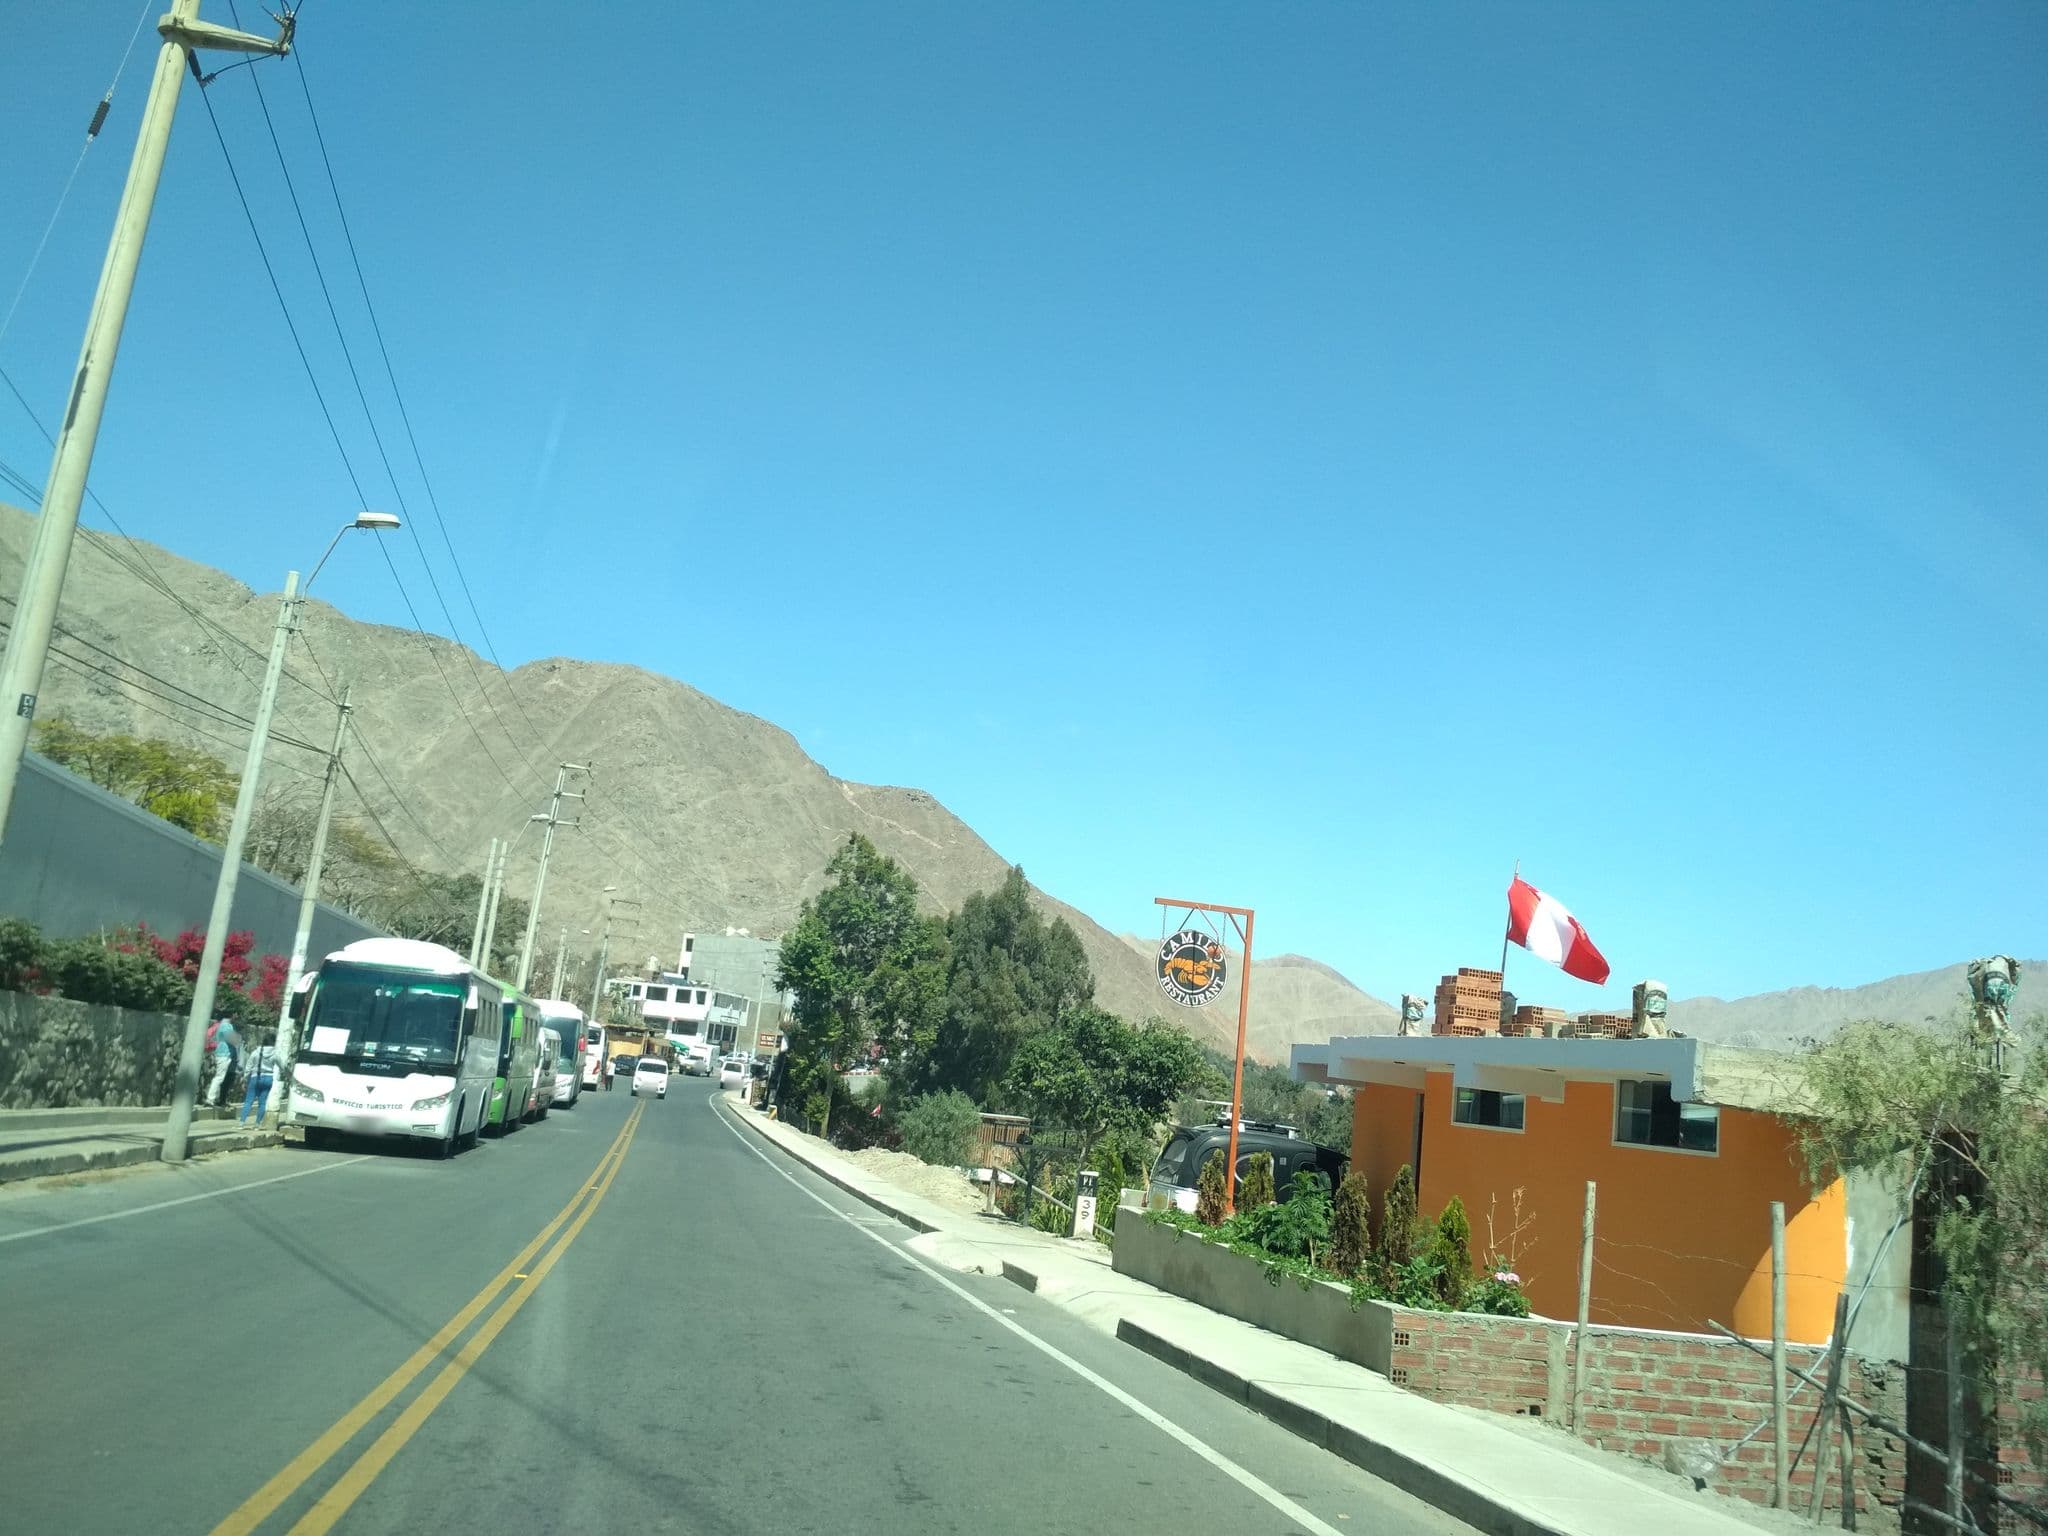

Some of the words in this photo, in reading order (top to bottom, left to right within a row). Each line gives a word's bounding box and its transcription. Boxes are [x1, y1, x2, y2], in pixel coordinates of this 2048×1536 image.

[1161, 976, 1224, 1005] RESTAURANT
[360, 1062, 391, 1070] FOTON
[332, 1097, 363, 1109] SERVICIO
